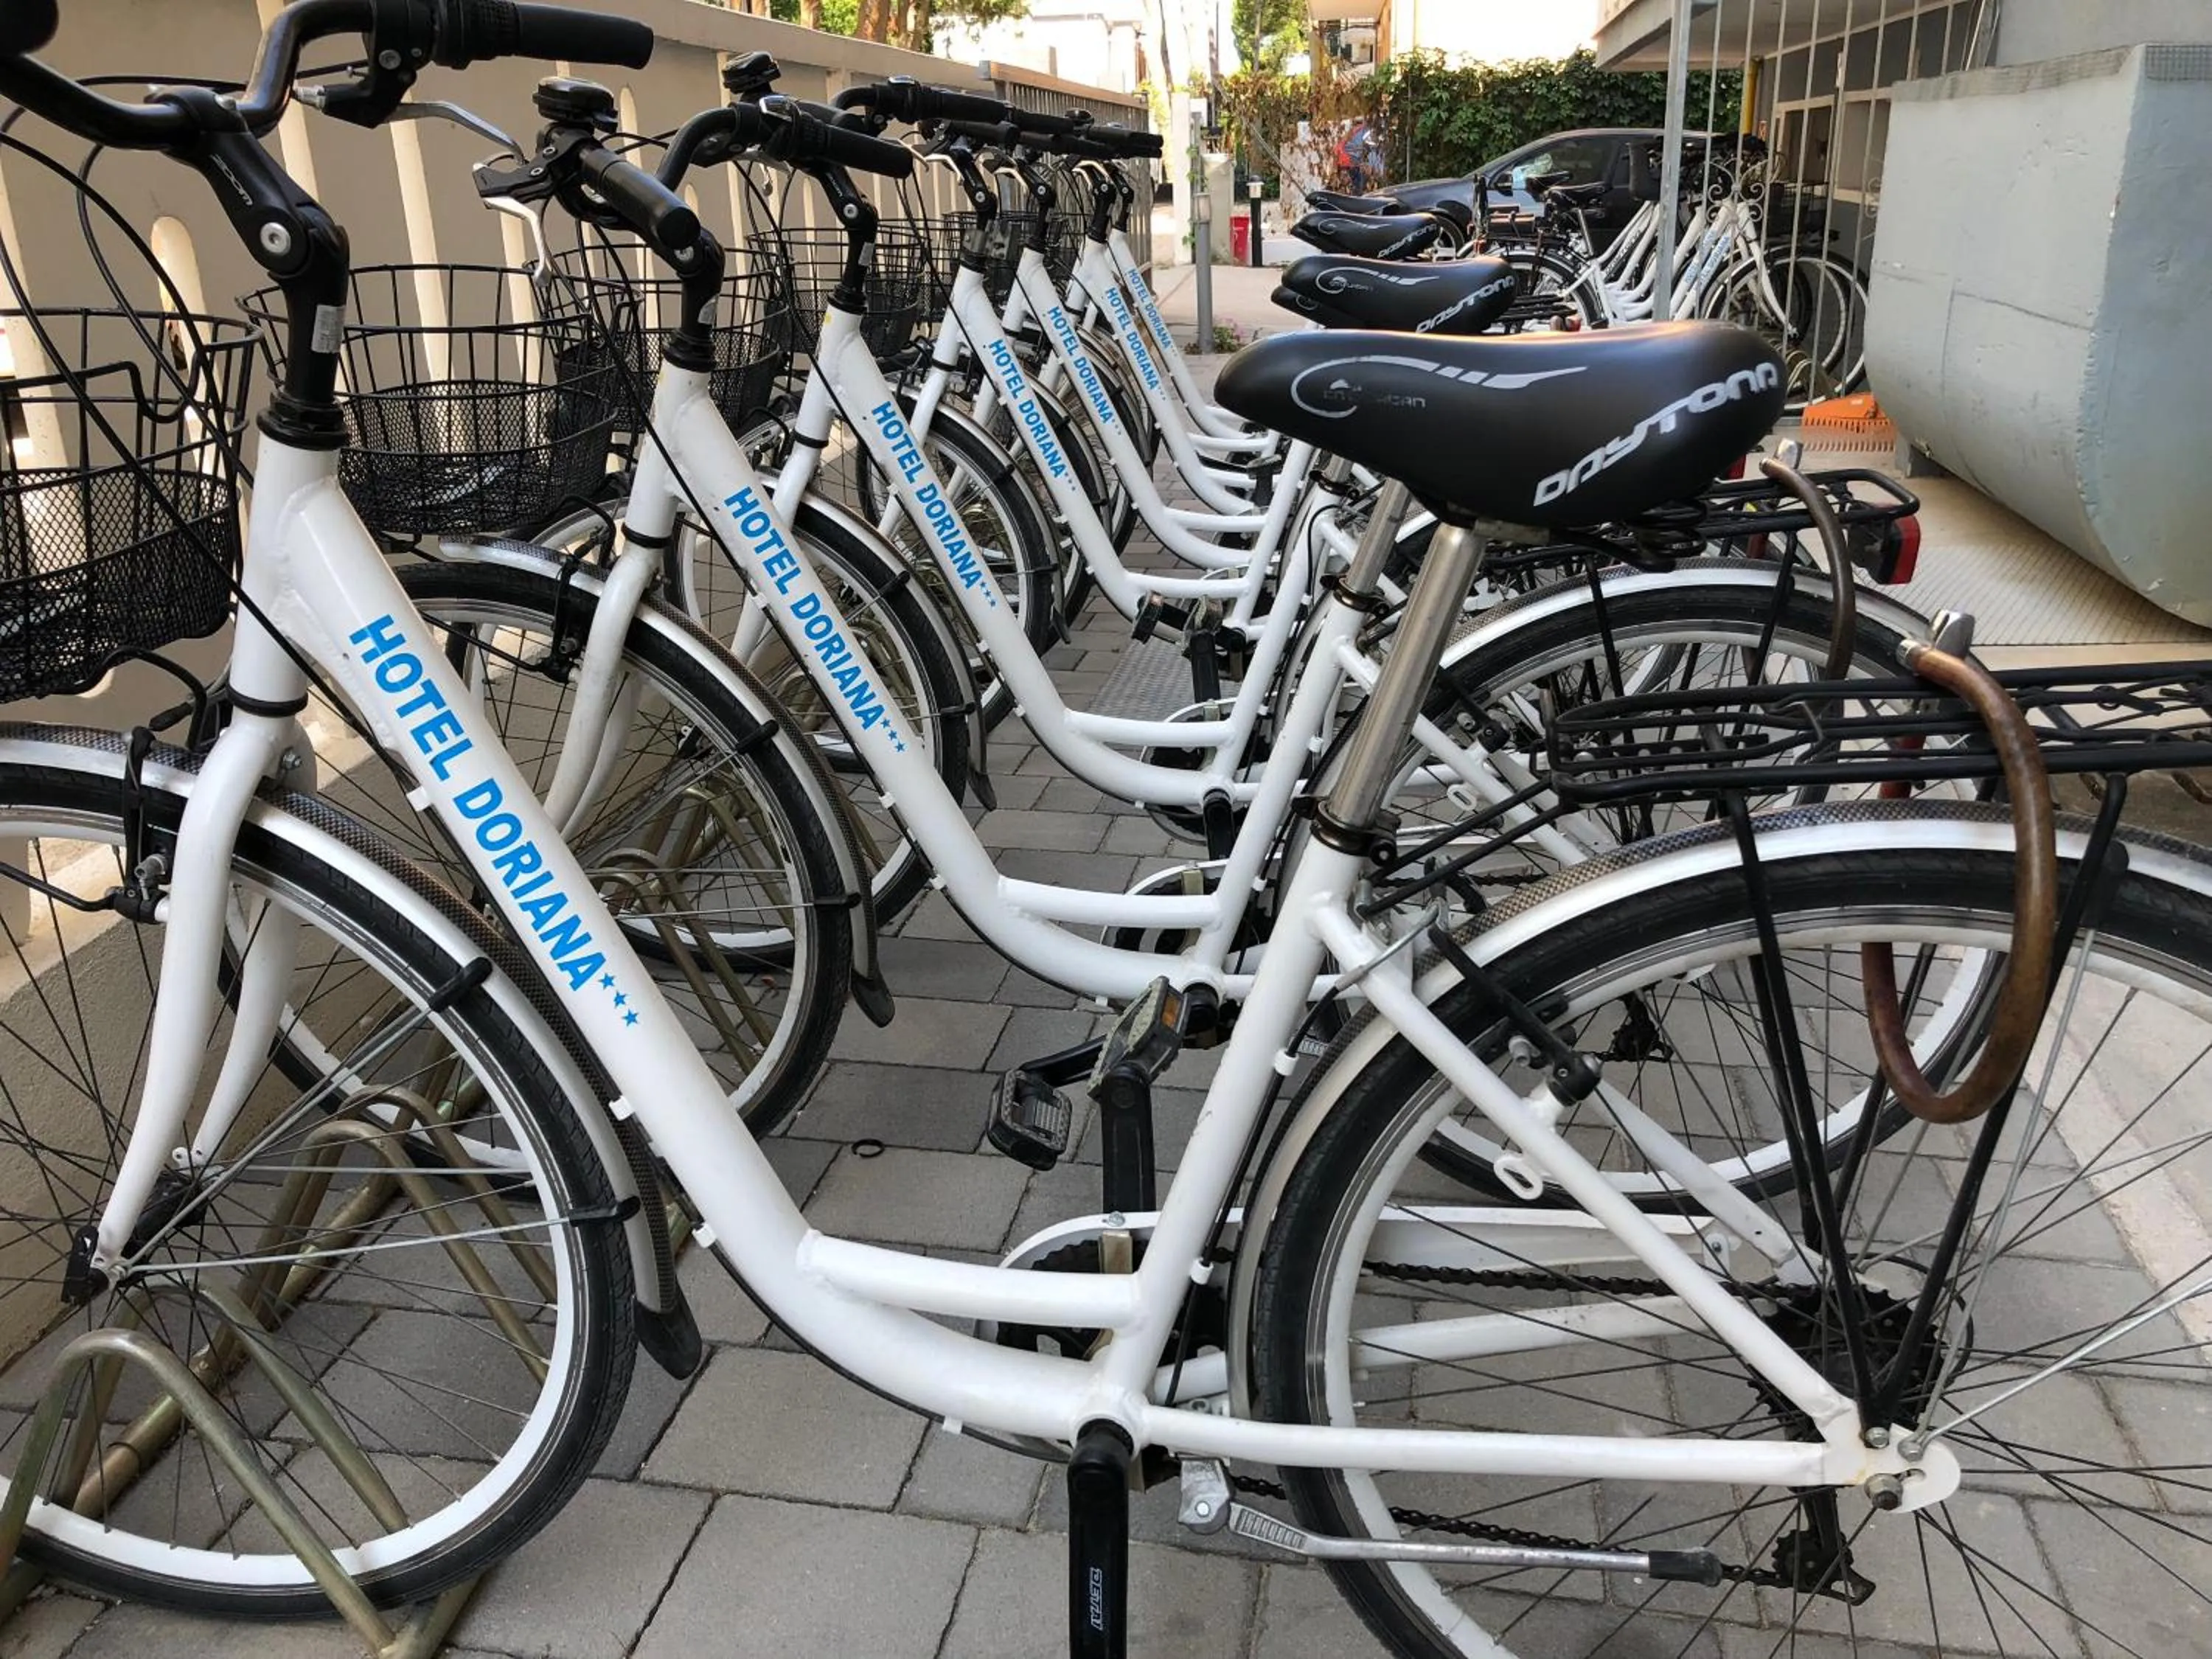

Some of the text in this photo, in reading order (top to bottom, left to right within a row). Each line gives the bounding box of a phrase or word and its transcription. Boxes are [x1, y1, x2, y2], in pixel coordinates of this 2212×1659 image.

[1047, 307, 1113, 423] HOTEL DORIANA
[1105, 288, 1160, 390] HOTEL DORIANA
[1128, 268, 1171, 349] HOTEL DORIANA
[989, 339, 1068, 478] HOTEL DORIANA
[1534, 362, 1778, 507] DAYTONA
[872, 401, 983, 589] HOTEL DORIANA
[725, 487, 886, 730] HOTEL DORIANA
[349, 615, 605, 991] HOTEL DORIANA
